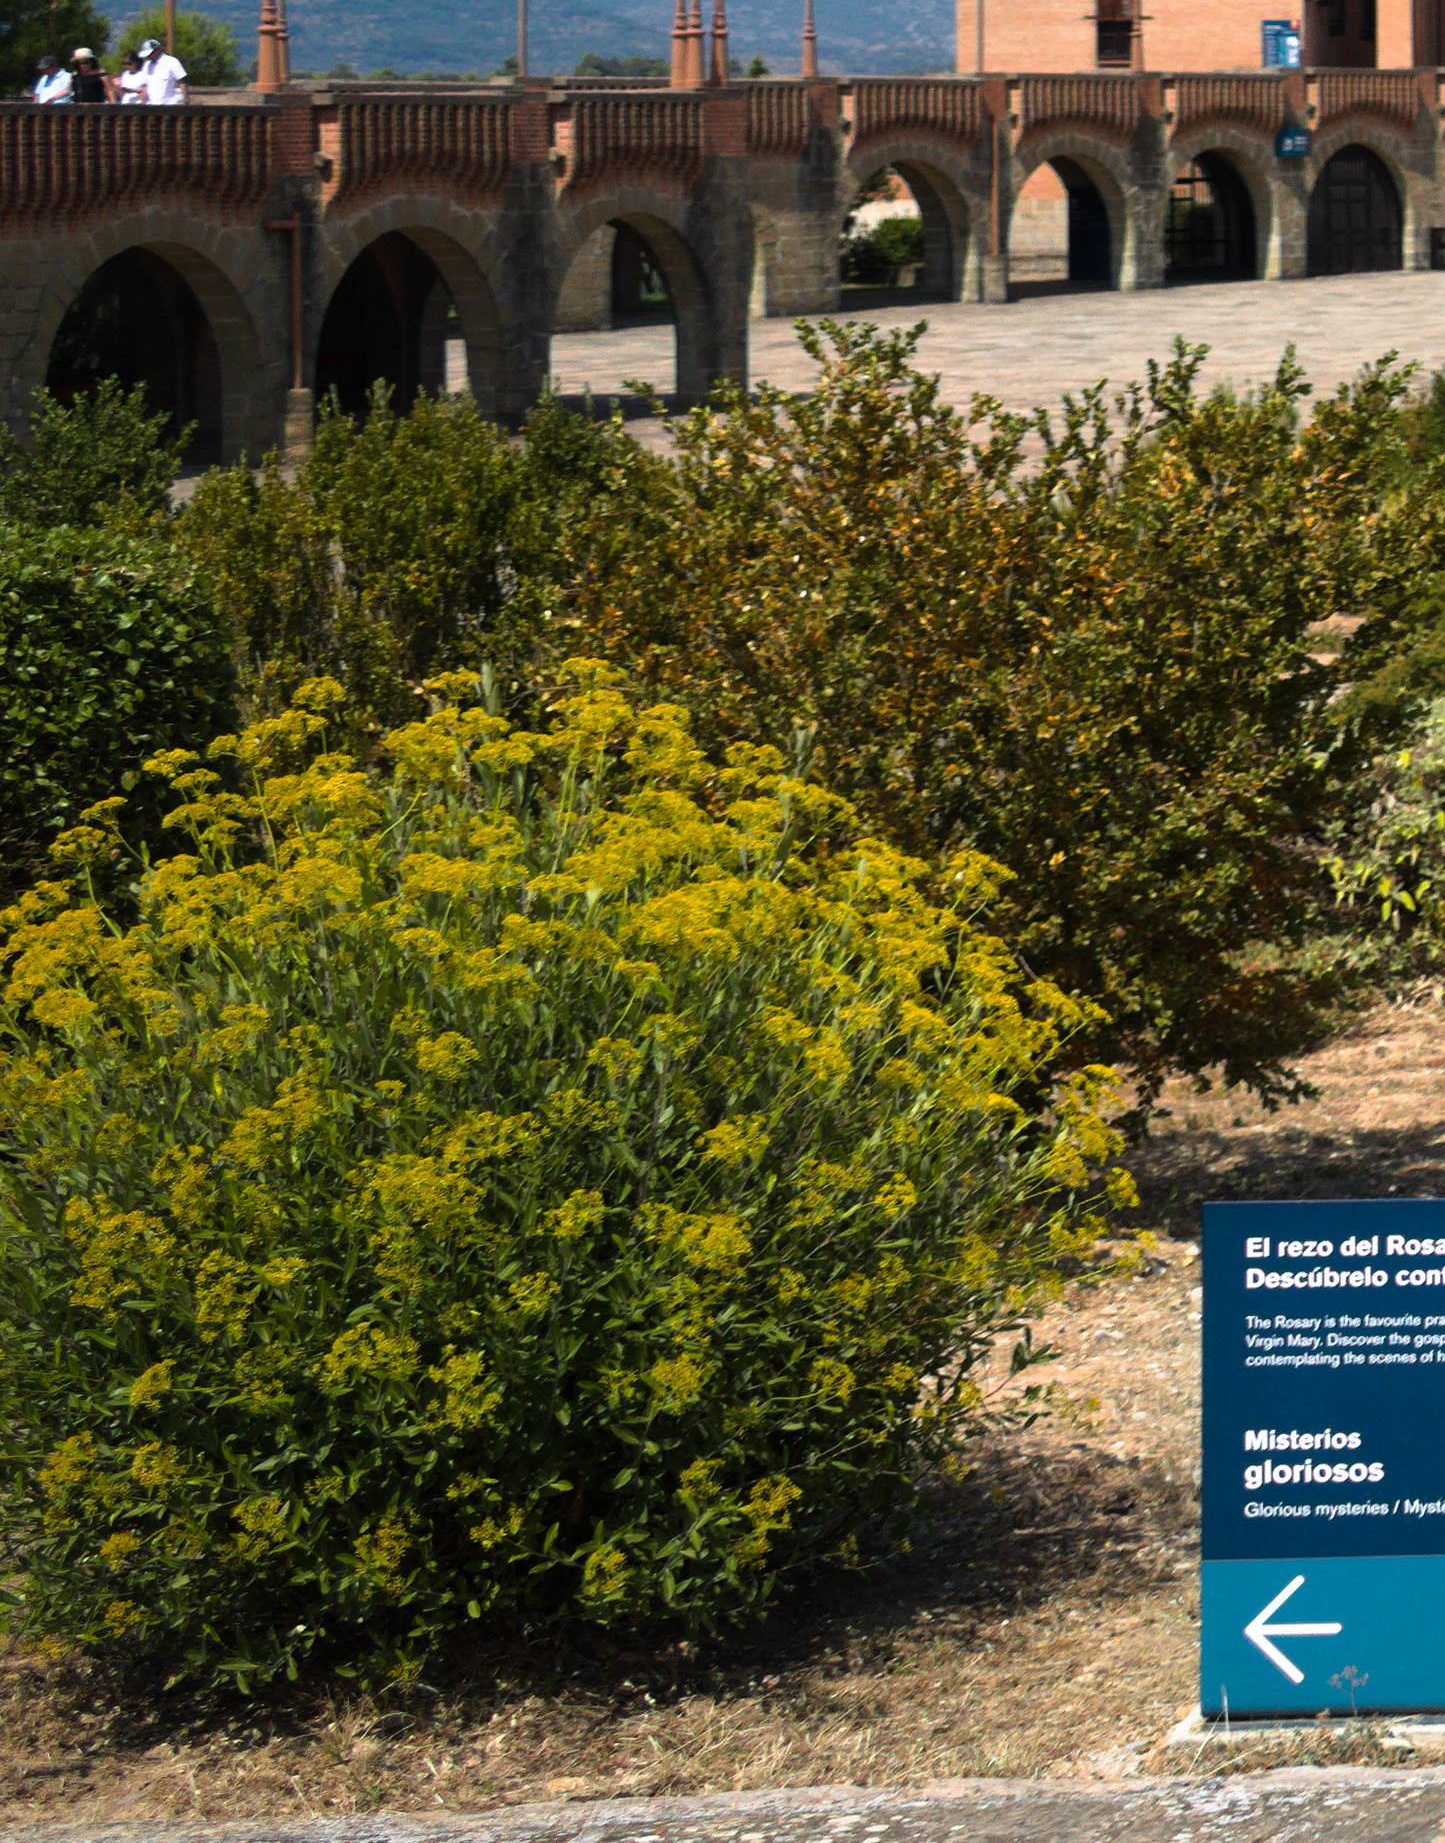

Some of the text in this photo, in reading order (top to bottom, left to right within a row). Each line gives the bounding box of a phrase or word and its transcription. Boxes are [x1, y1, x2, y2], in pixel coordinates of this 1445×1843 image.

[1245, 1236, 1271, 1259] El
[1277, 1240, 1334, 1258] rezo
[1339, 1235, 1379, 1257] del
[1245, 1266, 1389, 1290] Descúbrelo
[1244, 1315, 1272, 1330] The
[1274, 1314, 1322, 1332] Rosary
[1323, 1315, 1337, 1328] is
[1338, 1314, 1362, 1328] the
[1363, 1313, 1422, 1328] favourite
[1244, 1334, 1285, 1351] Virgin
[1286, 1333, 1324, 1351] Mary.
[1326, 1332, 1387, 1347] Discover
[1388, 1332, 1411, 1346] the
[1245, 1351, 1341, 1369] contemplating
[1342, 1351, 1366, 1365] the
[1367, 1353, 1418, 1365] scenes
[1419, 1349, 1435, 1364] of
[1244, 1428, 1362, 1451] Misterios
[1243, 1458, 1385, 1490] gloriosos
[1243, 1501, 1312, 1518] Glorious
[1314, 1500, 1390, 1520] mysteries
